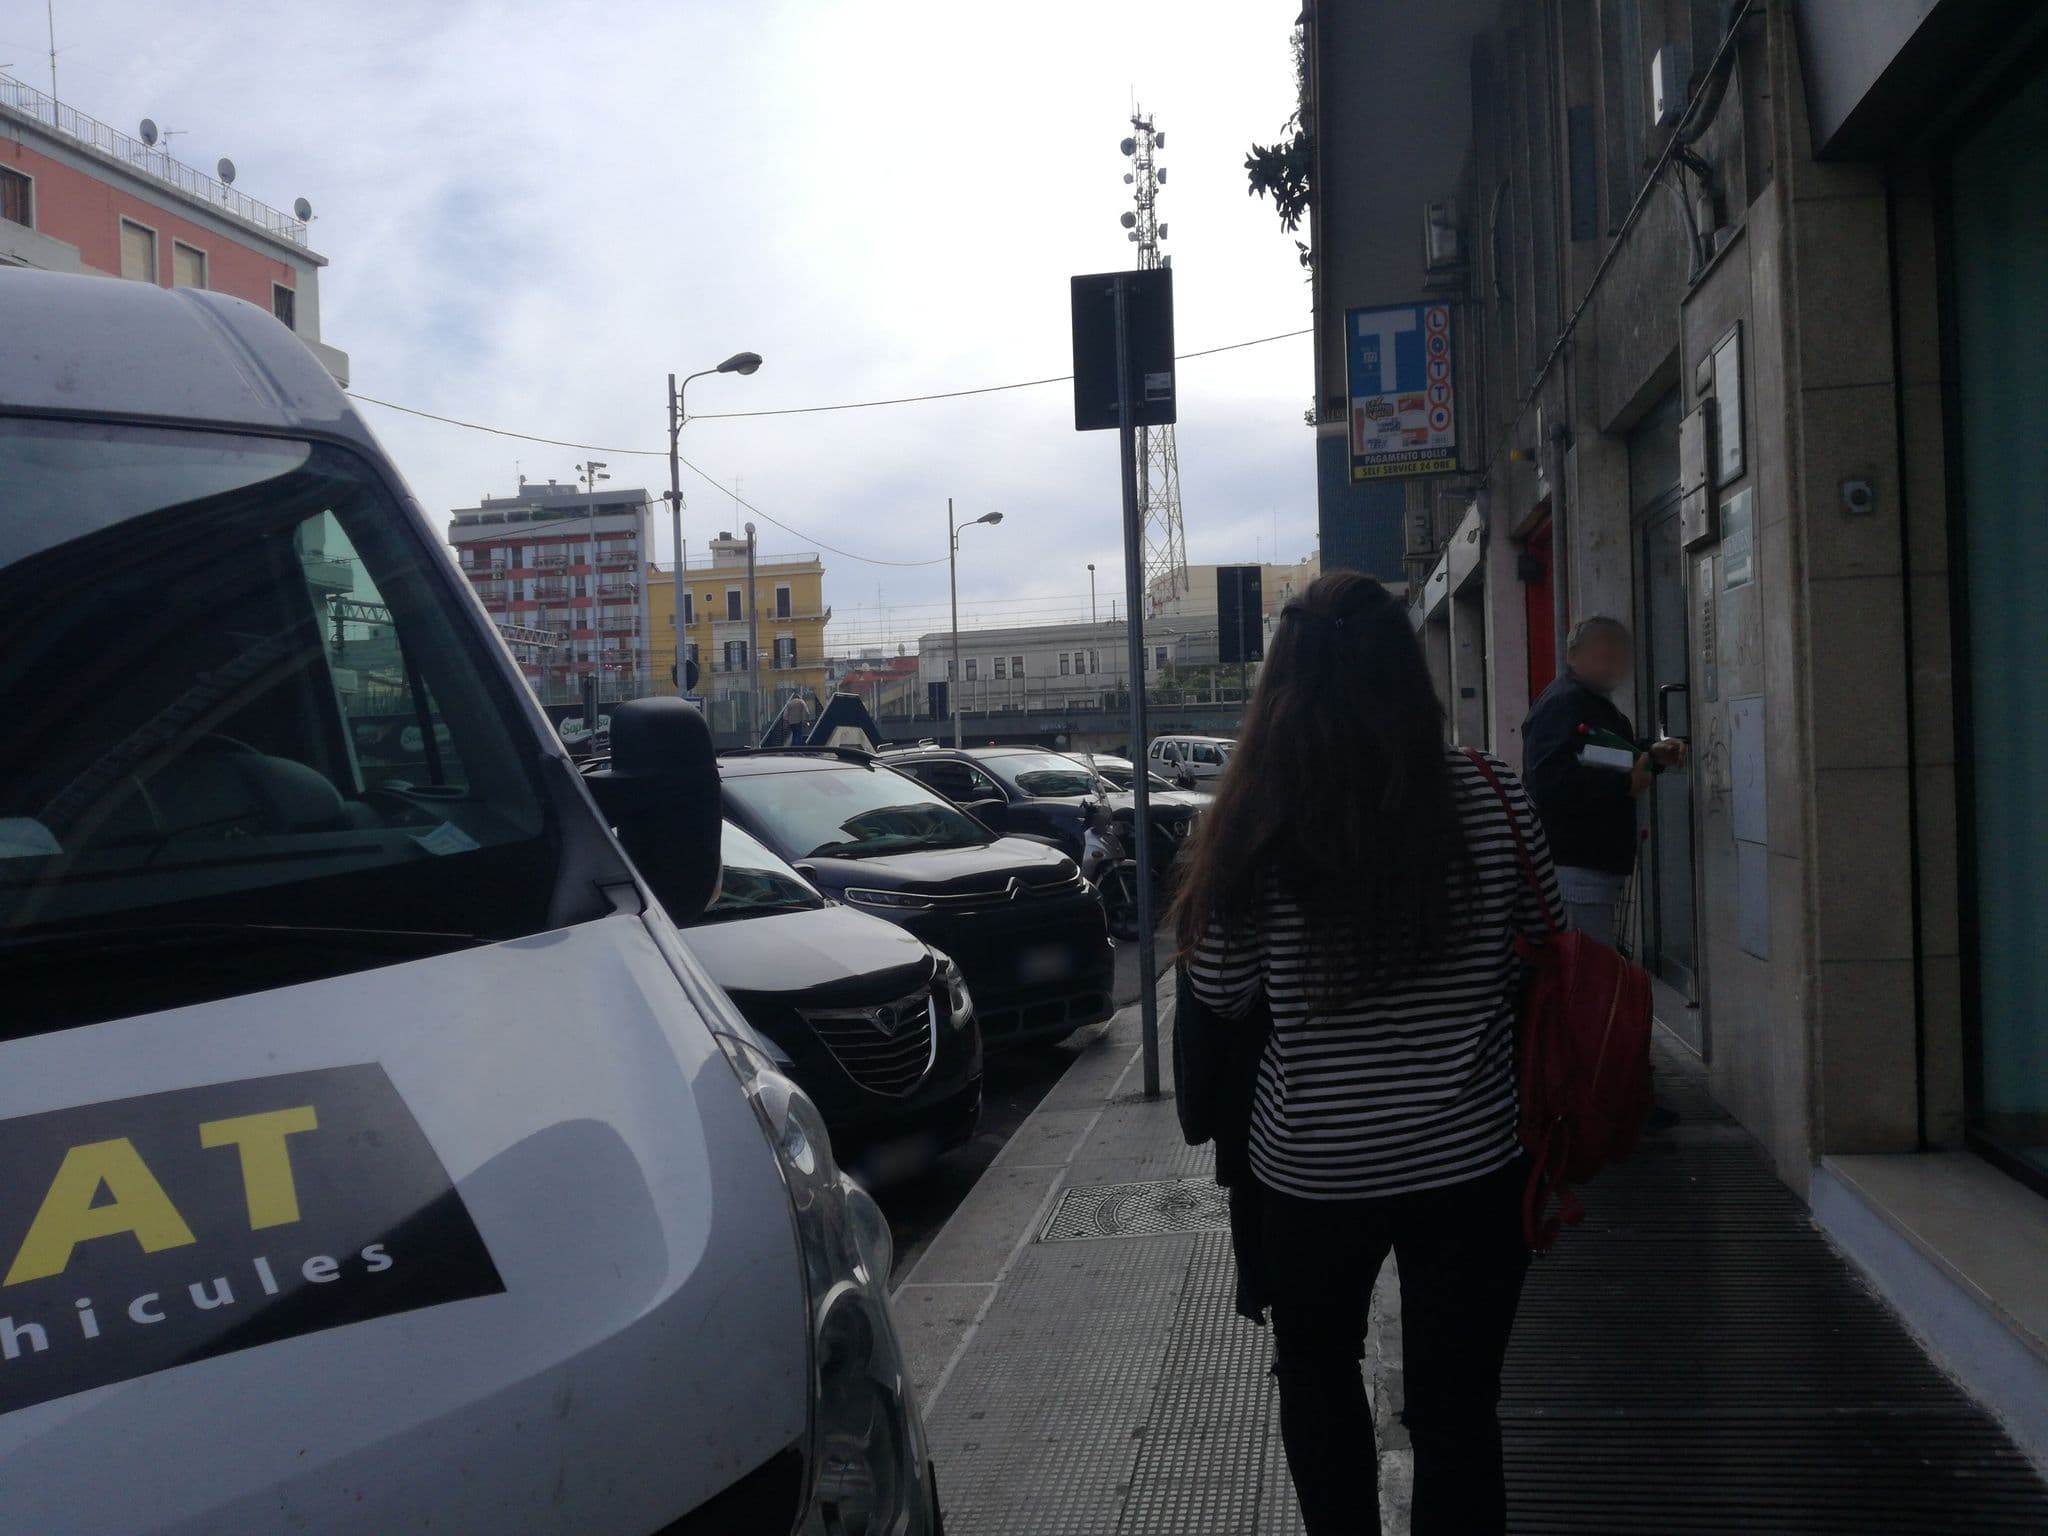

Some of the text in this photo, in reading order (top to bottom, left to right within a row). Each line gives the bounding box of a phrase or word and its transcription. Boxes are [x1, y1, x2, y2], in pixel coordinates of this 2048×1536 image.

[1358, 309, 1417, 391] T
[1430, 311, 1448, 424] LOTTO
[1362, 460, 1450, 476] SELF SERVICE 24 ORE
[1364, 448, 1447, 464] PAGAMENTO BOLLO
